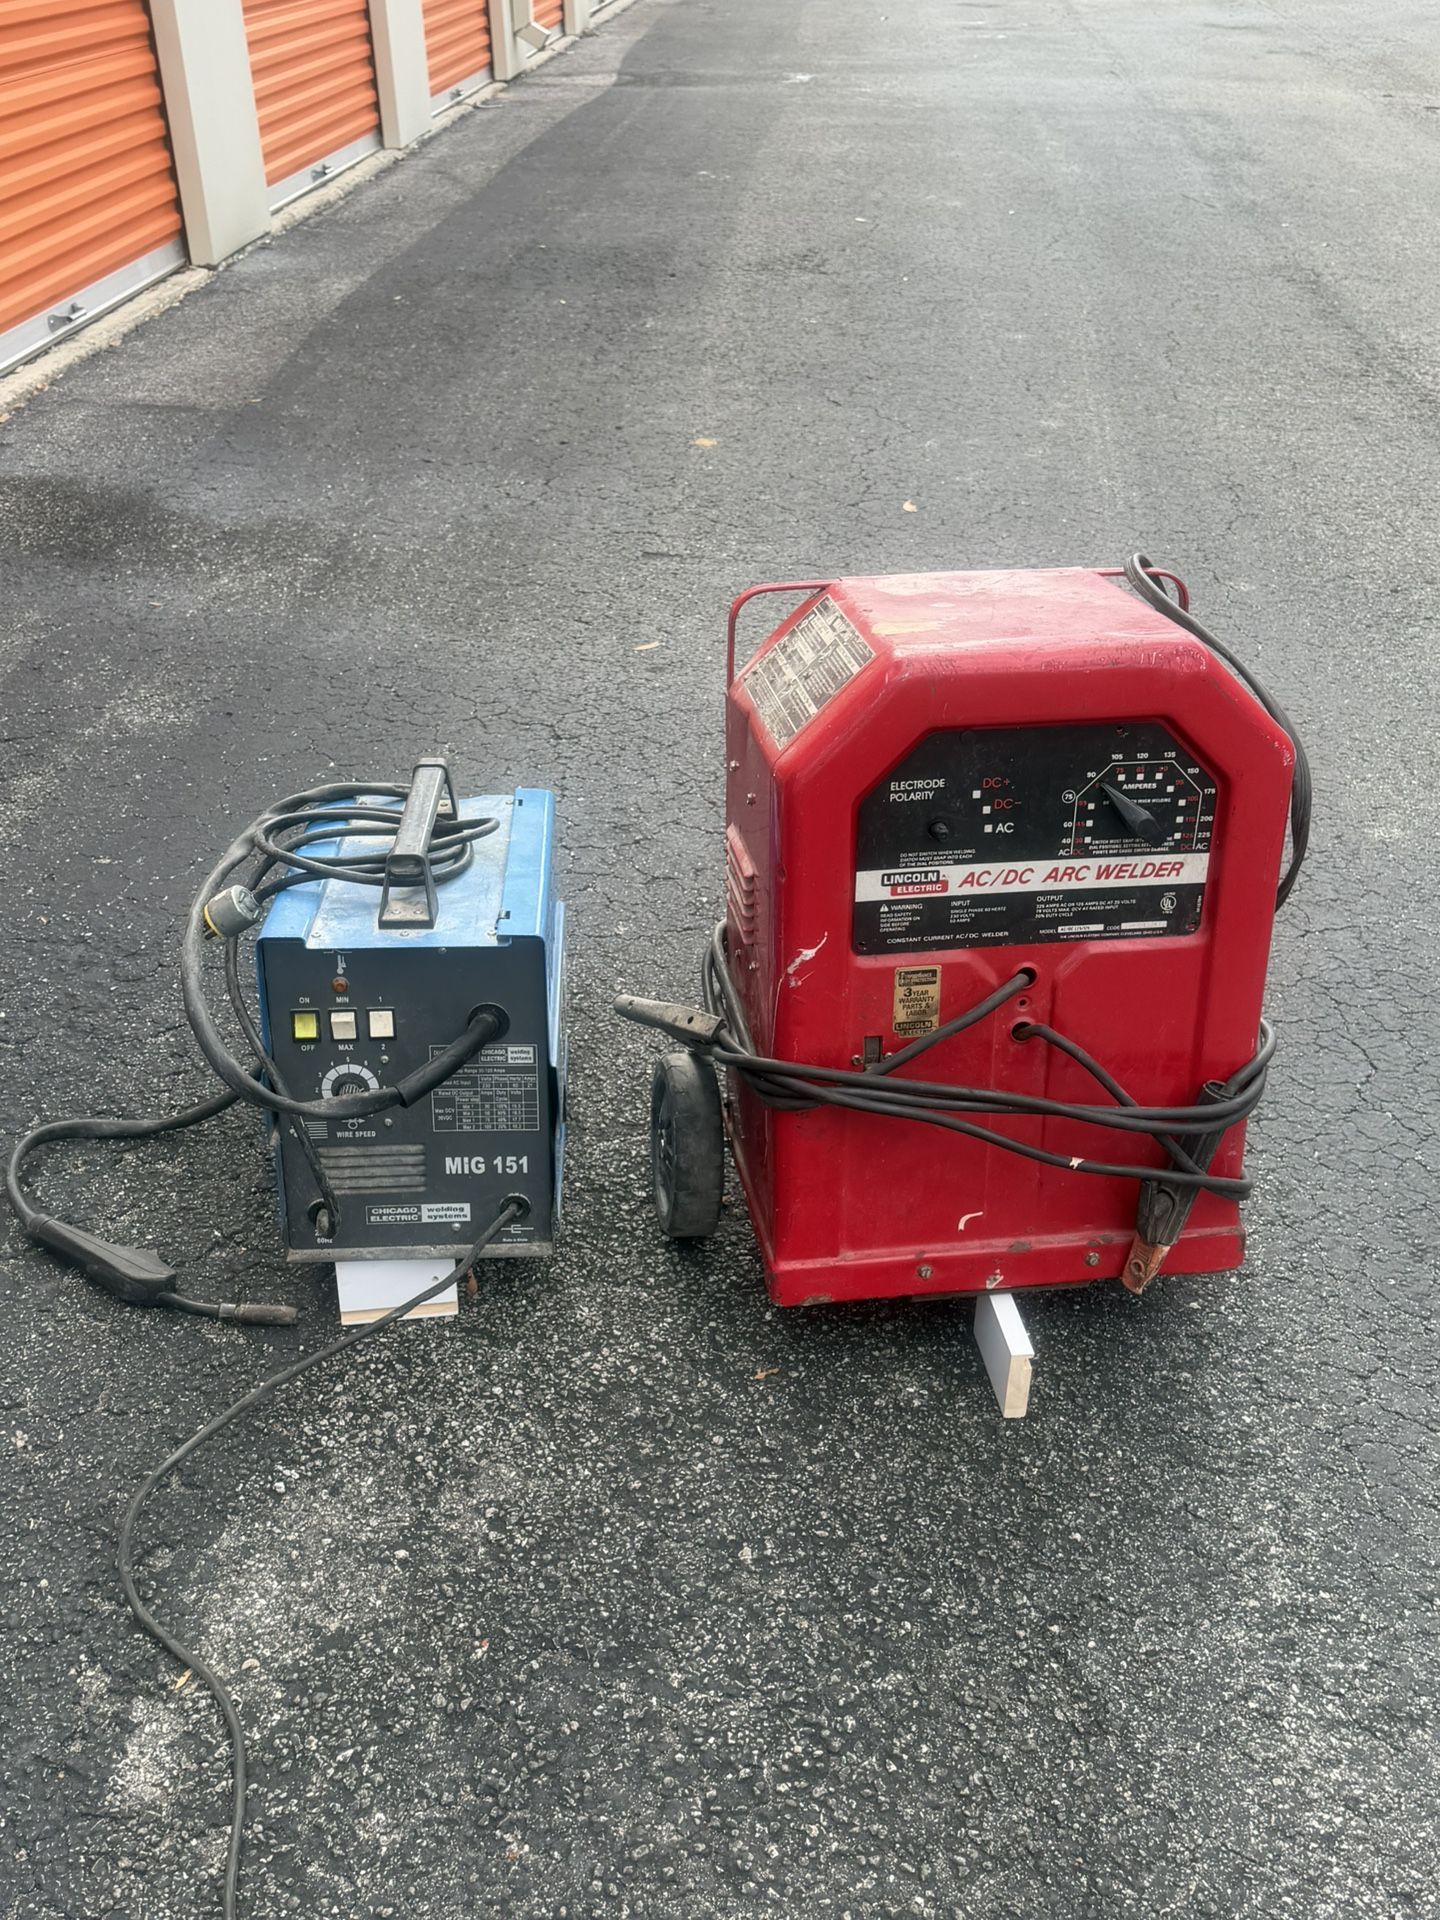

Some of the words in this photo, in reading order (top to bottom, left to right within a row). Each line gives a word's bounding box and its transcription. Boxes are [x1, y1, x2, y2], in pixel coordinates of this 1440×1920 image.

[890, 778, 946, 791] ELECTRODE
[890, 791, 935, 802] POLARITY
[995, 822, 1015, 834] AC
[1196, 842, 1208, 850] AC
[1058, 849, 1070, 857] AC
[883, 872, 937, 884] LINCOLN
[958, 868, 1035, 888] AC/DC
[1042, 865, 1091, 883] ARC
[1095, 861, 1185, 881] WELDER
[897, 884, 942, 894] ELECTRIC
[904, 988, 912, 997] 3
[899, 996, 934, 1004] WARRANTY
[896, 1021, 932, 1030] LINCOLN
[445, 1157, 485, 1175] MIG
[494, 1156, 528, 1174] 151
[371, 1207, 417, 1215] CHICAGO
[370, 1214, 418, 1222] ELECTRIC
